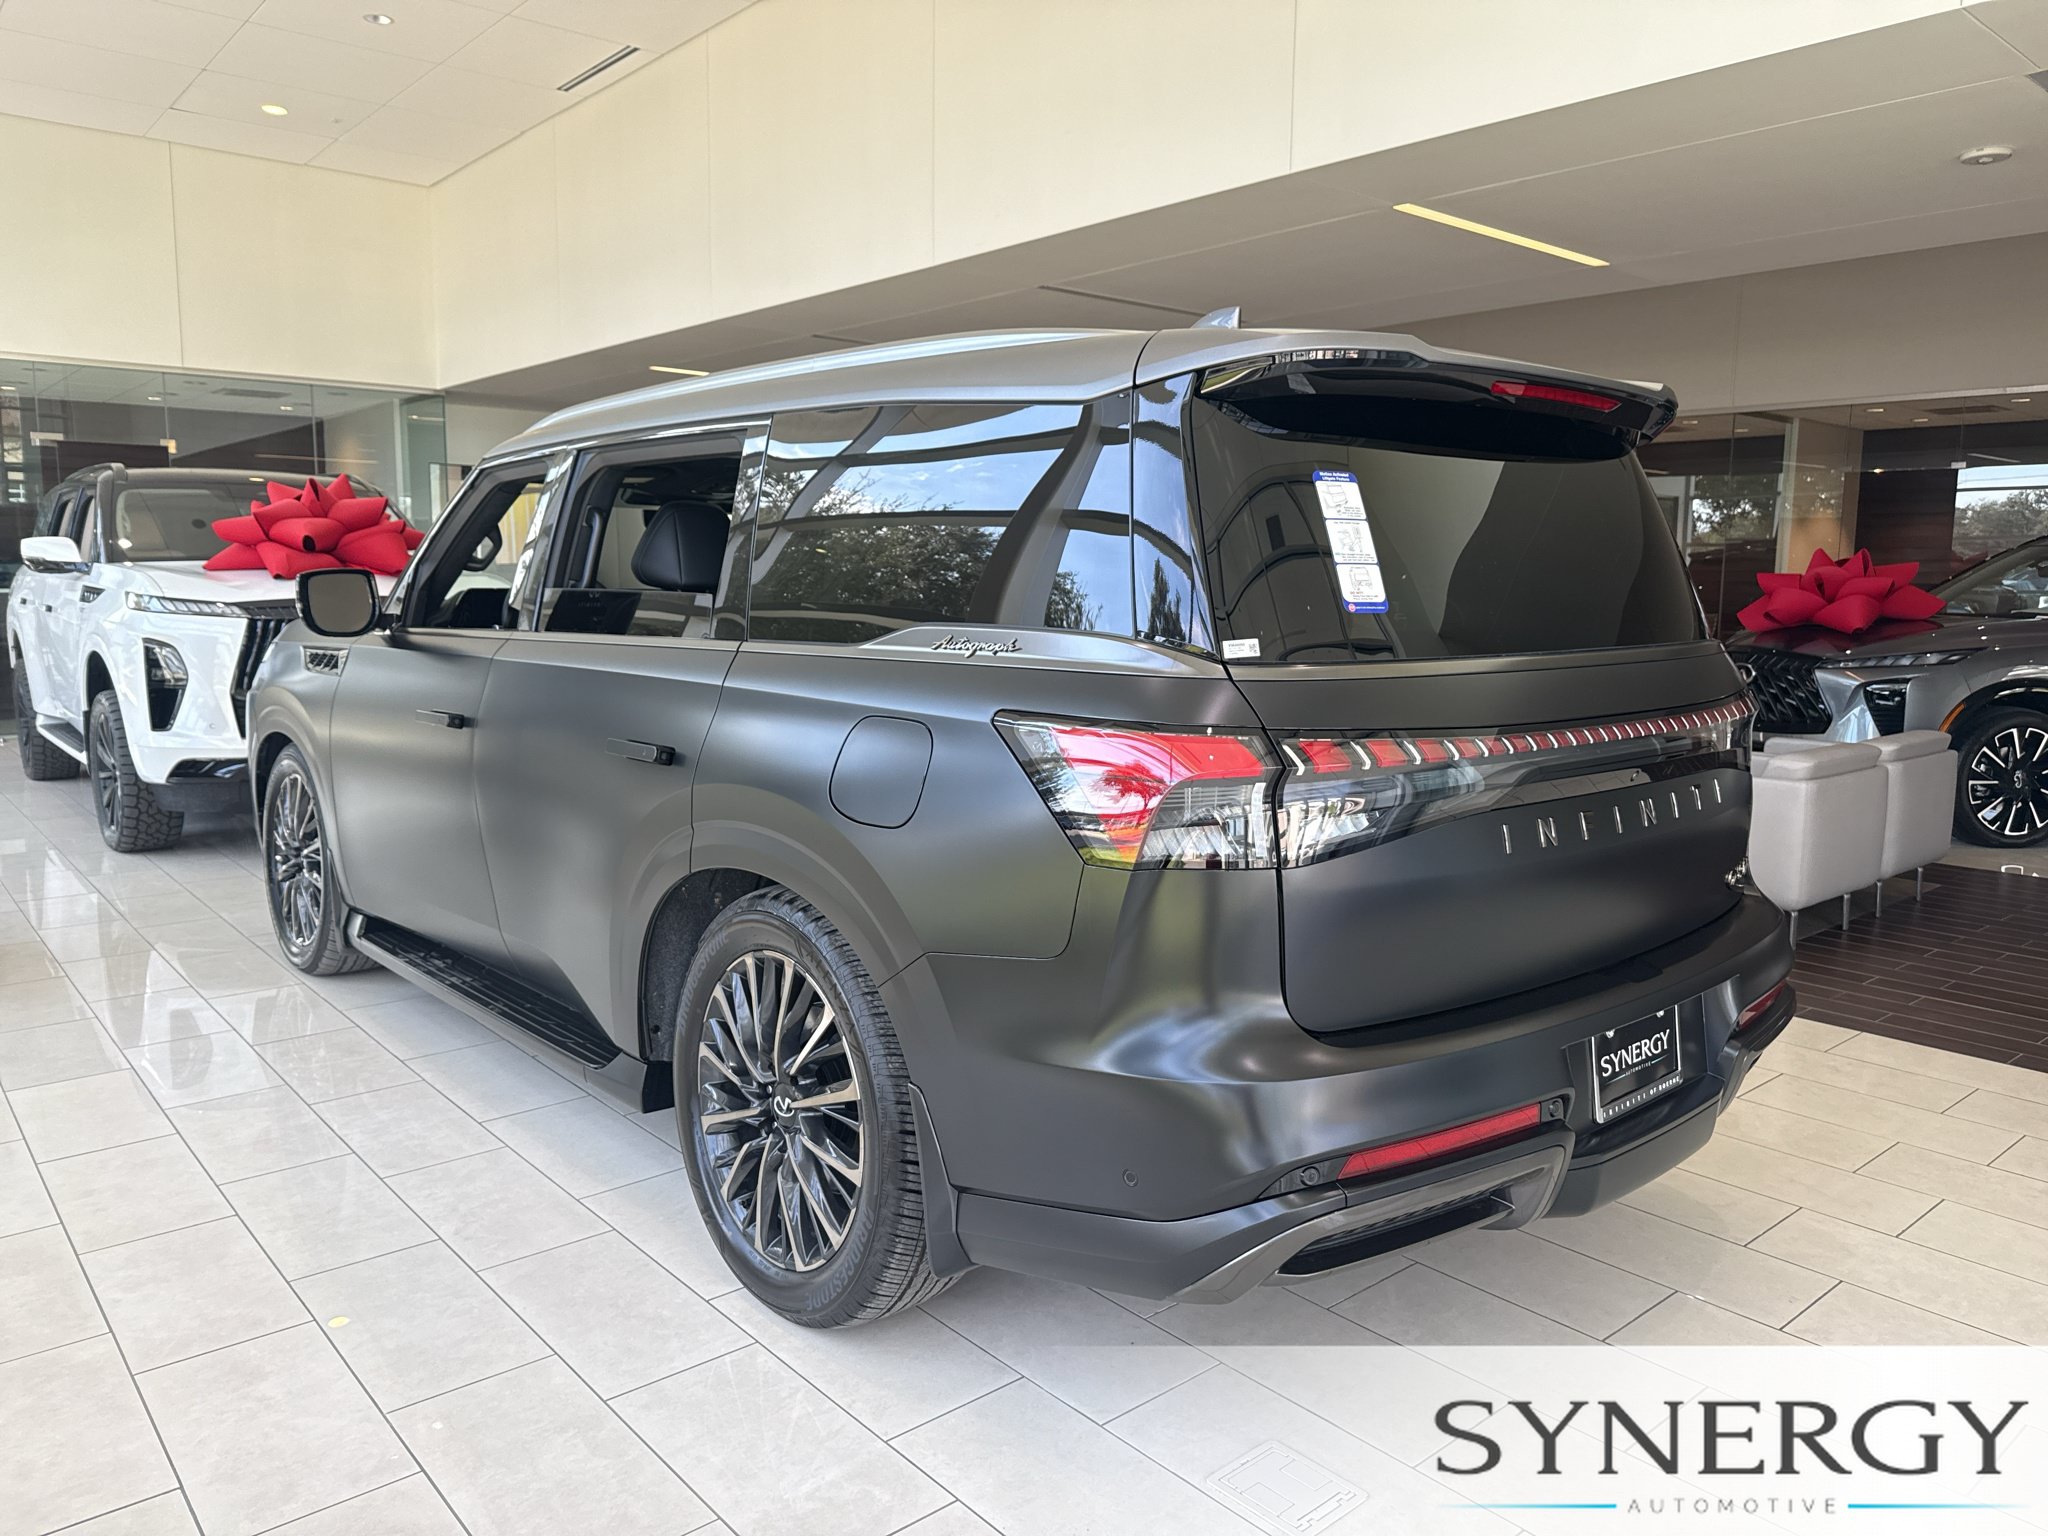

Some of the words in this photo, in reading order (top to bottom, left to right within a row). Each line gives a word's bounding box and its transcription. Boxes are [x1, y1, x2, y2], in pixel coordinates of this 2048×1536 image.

[931, 634, 1022, 658] Autograph
[1502, 778, 1722, 854] INFINITI
[1600, 1028, 1670, 1077] SYNERGY
